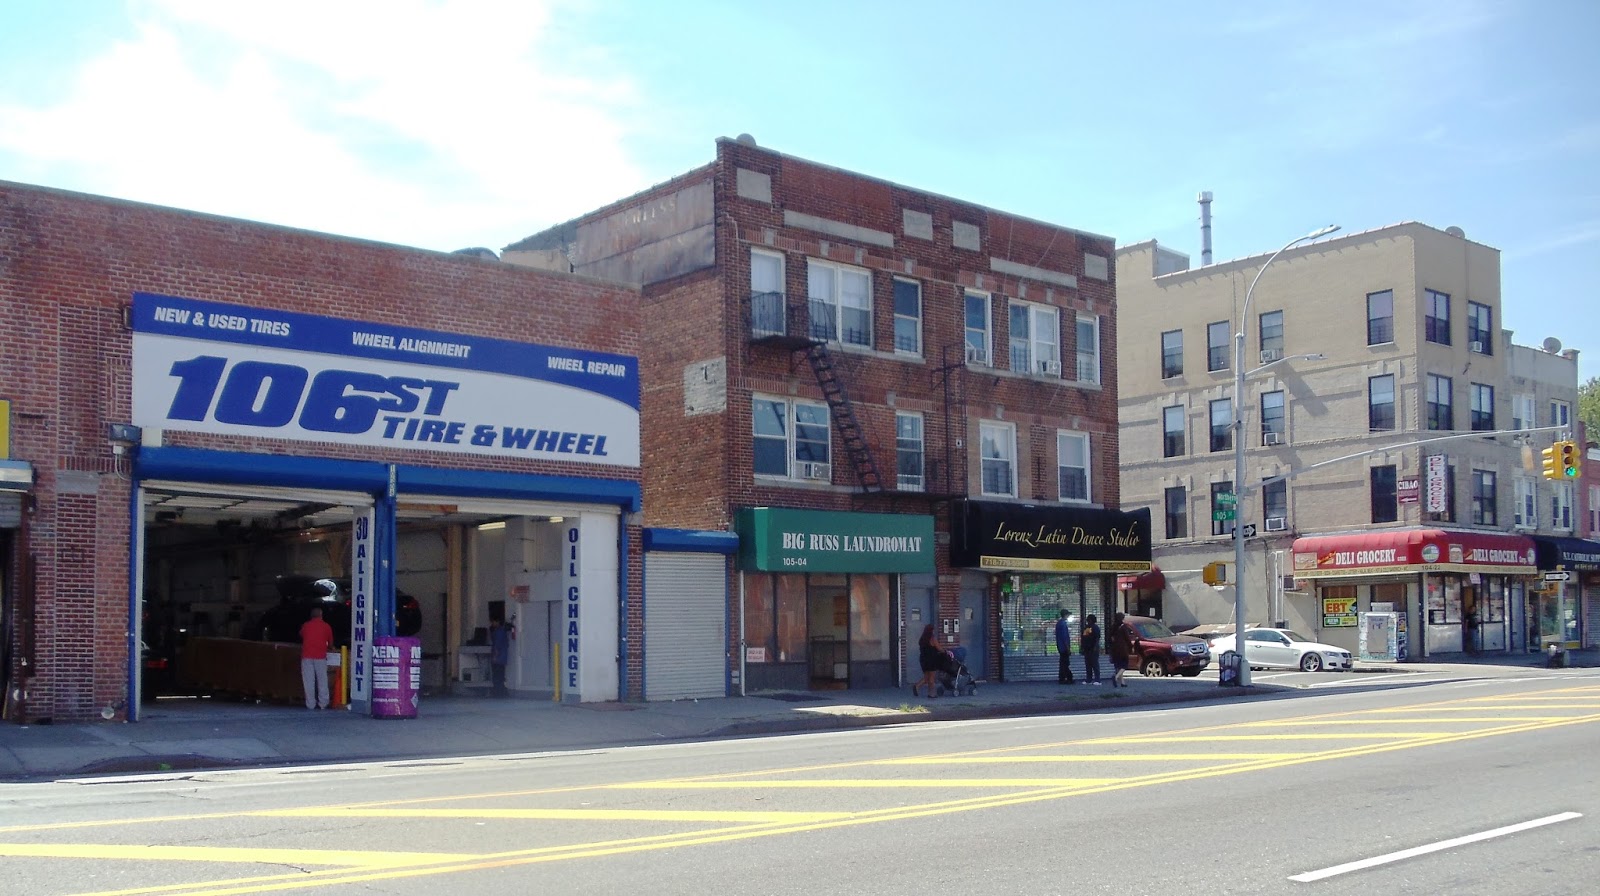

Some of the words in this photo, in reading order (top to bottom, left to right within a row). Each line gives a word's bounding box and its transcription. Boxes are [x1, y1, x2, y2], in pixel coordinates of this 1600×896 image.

[154, 306, 190, 324] NEW
[192, 311, 204, 326] &
[208, 313, 247, 331] USED
[250, 318, 290, 336] TIRES
[352, 332, 396, 350] WHEEL
[399, 337, 471, 358] ALIGNMENT
[547, 356, 585, 373] WHEEL
[587, 361, 626, 378] REPAIR
[166, 354, 386, 435] 106
[382, 375, 460, 416] ST
[381, 415, 467, 445] TIRE
[470, 424, 497, 447] &
[500, 427, 608, 457] WHEEL
[1216, 511, 1227, 520] 105
[356, 516, 368, 541] 3D
[993, 521, 1038, 548] Lorenz
[1035, 524, 1068, 545] Latin
[1071, 526, 1105, 546] Dance
[1106, 520, 1140, 548] Studio
[568, 528, 579, 577] OIL
[782, 532, 805, 550] BIG
[809, 533, 840, 551] RUSS
[843, 535, 922, 553] LAUNDROMAT
[783, 557, 807, 566] 105-04
[1335, 552, 1355, 566] DELI
[1356, 549, 1397, 564] GROCERY
[1473, 549, 1488, 562] DELI
[1489, 549, 1518, 563] GROCERY
[354, 544, 367, 692] ALIGNMENT
[1326, 602, 1347, 613] EBT
[567, 586, 579, 688] CHANGE
